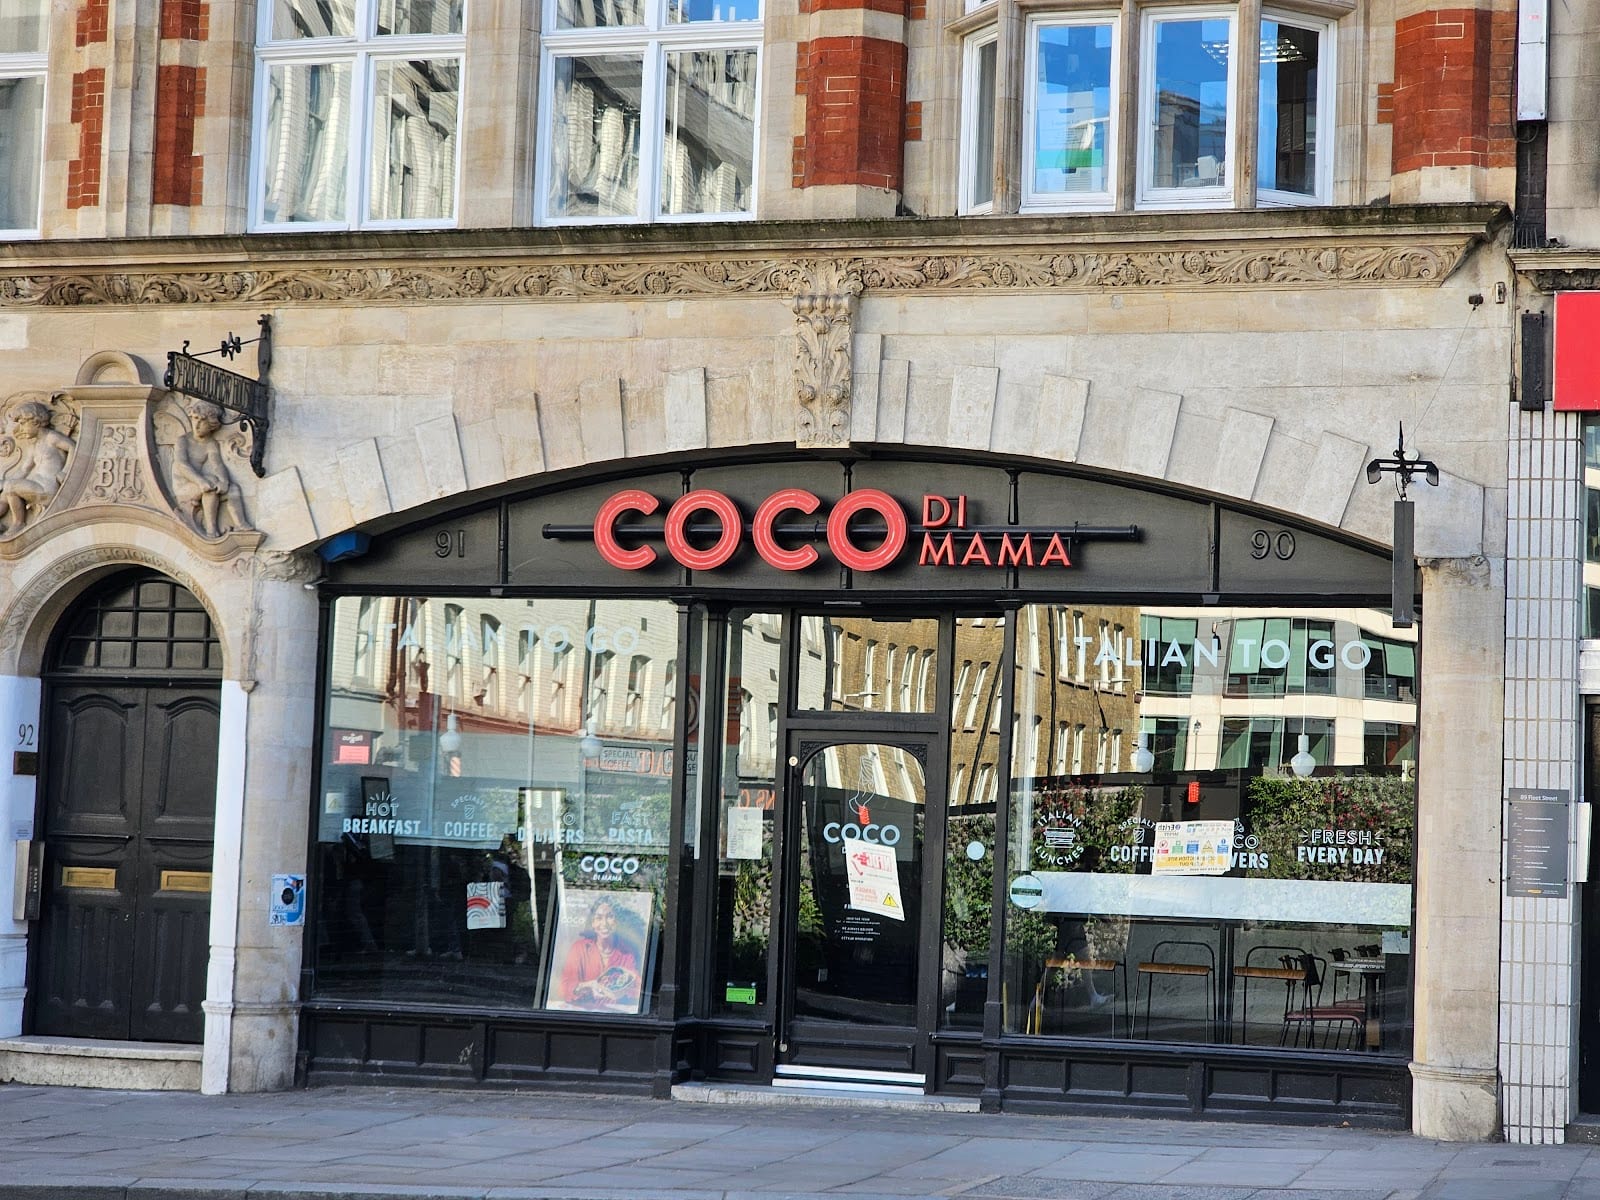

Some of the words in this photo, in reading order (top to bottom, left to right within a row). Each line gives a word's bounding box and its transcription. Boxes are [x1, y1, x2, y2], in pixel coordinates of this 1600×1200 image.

[922, 493, 967, 529] DI
[594, 488, 907, 571] COCO
[435, 529, 465, 558] 91
[919, 532, 1072, 566] MAMA
[1250, 530, 1296, 560] 90
[523, 624, 570, 655] TO
[584, 624, 640, 655] GO
[1237, 638, 1290, 669] TO
[1309, 639, 1372, 670] GO
[17, 723, 34, 746] 92
[366, 802, 399, 817] HOT
[1037, 810, 1082, 828] ITALIAN
[343, 818, 421, 835] BREAKFAST
[444, 822, 494, 837] COFFEE
[823, 822, 900, 845] COCO
[1118, 817, 1157, 832] SPECIALT
[609, 828, 653, 844] PASTA
[1312, 829, 1372, 845] FRESH
[1035, 845, 1085, 865] LUNCHES
[1110, 845, 1155, 862] COFF
[1297, 846, 1348, 864] EVERY
[1353, 847, 1385, 865] DAY
[580, 855, 639, 874] COCO
